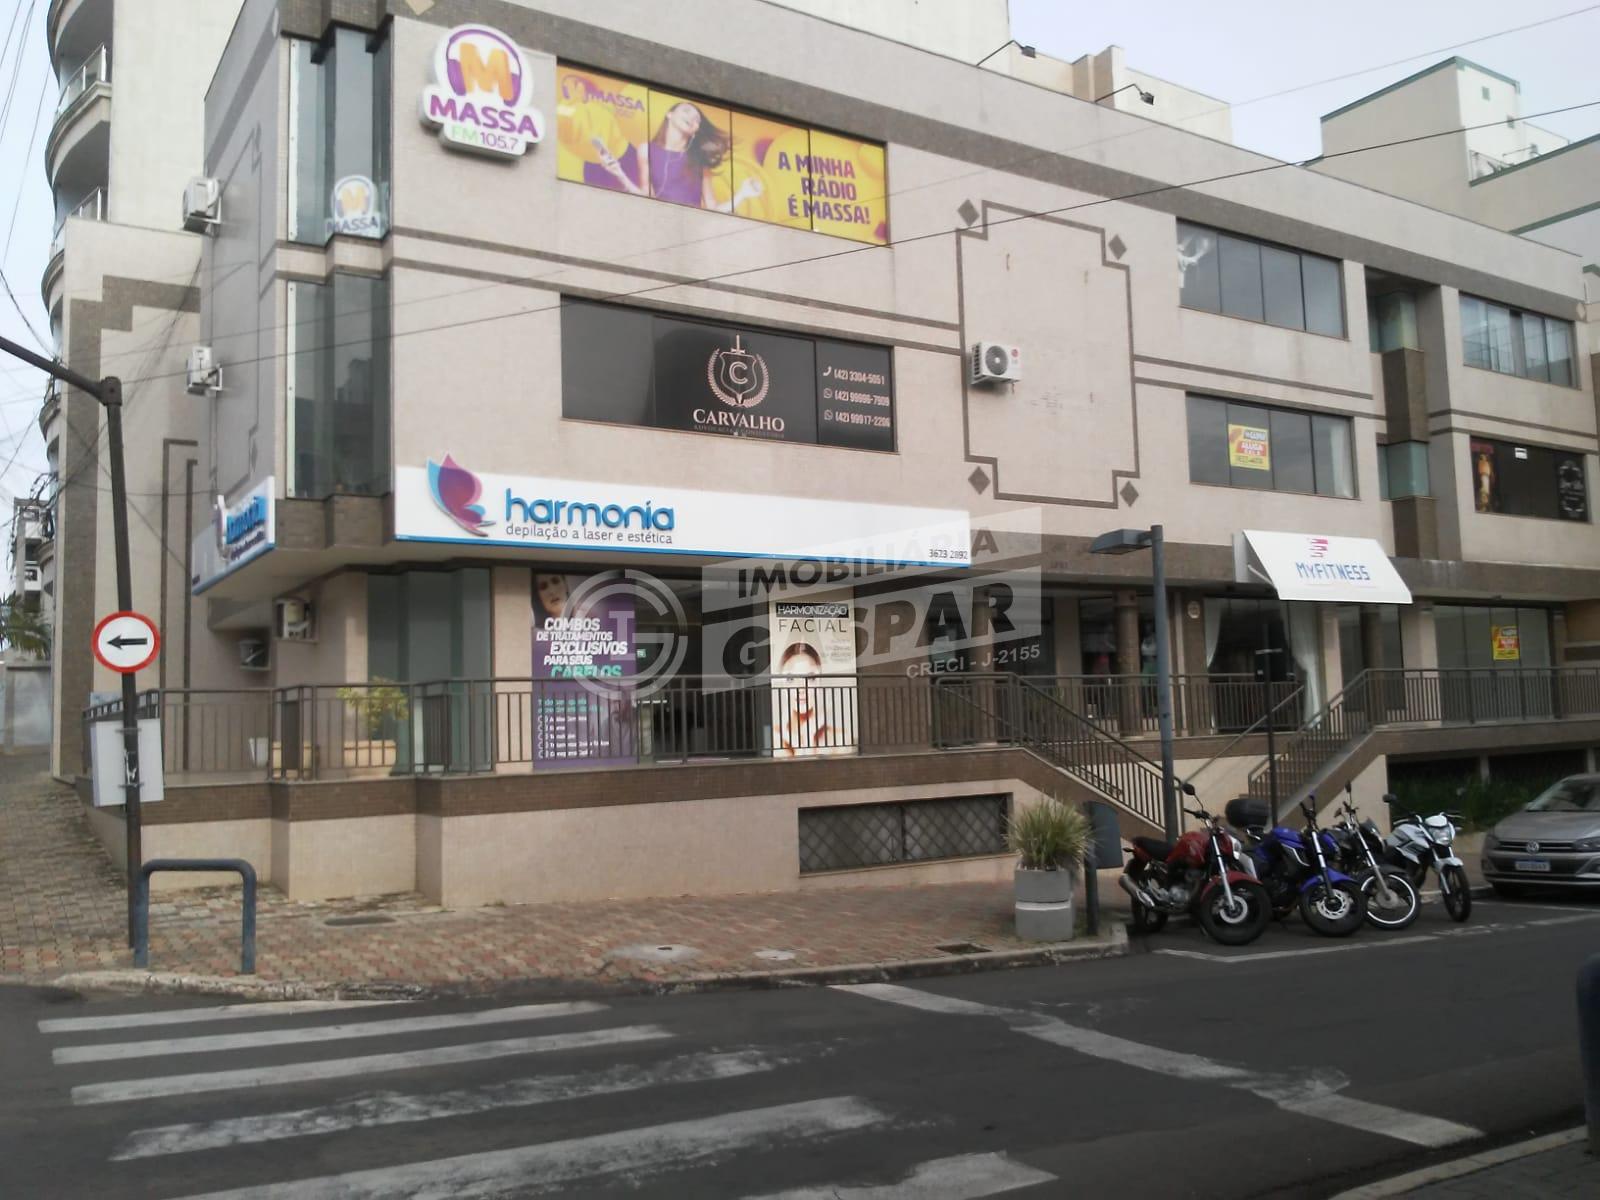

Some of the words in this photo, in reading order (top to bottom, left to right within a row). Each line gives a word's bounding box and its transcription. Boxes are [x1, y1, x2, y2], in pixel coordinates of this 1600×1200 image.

[430, 94, 539, 138] MASSA
[452, 124, 479, 142] FM
[778, 151, 791, 171] A
[795, 153, 856, 179] MINHA
[801, 174, 857, 201] RÁDIO
[788, 194, 799, 217] É
[803, 199, 871, 225] MASSA!
[326, 216, 379, 232] MASSA
[693, 408, 785, 432] CARVALHO
[506, 523, 568, 540] depilação
[572, 530, 579, 539] a
[584, 527, 612, 542] laser
[617, 532, 623, 541] e
[628, 530, 673, 545] estética
[777, 604, 847, 617] HARMONIZAÇÃO
[544, 617, 601, 632] COMBOS
[778, 619, 847, 633] FACIAL
[536, 631, 549, 641] DE
[550, 631, 613, 641] TRATAMENTOS
[550, 641, 628, 655] EXCLUSIVOS
[543, 655, 568, 665] PARA
[569, 655, 593, 665] SEUS
